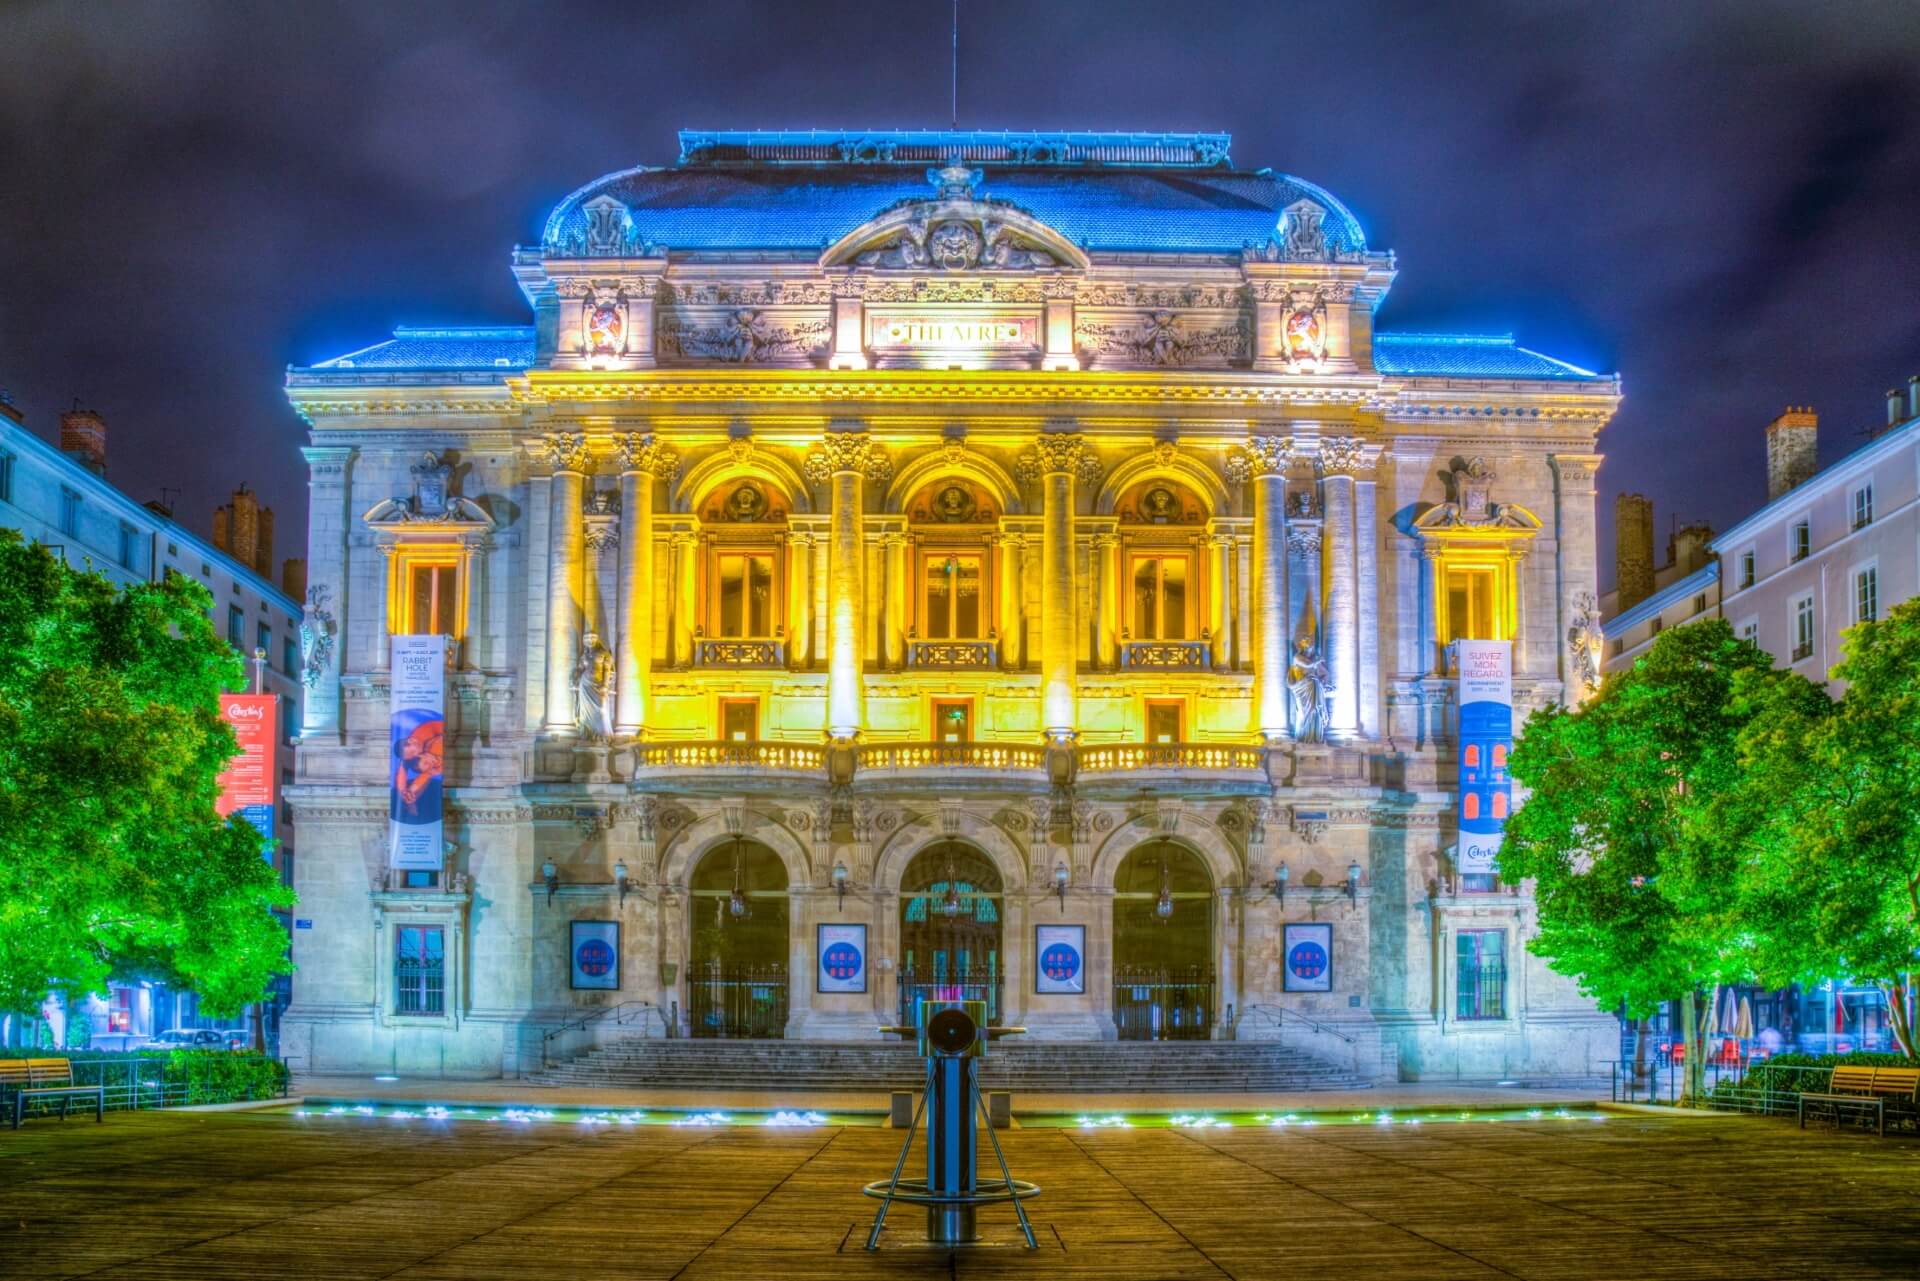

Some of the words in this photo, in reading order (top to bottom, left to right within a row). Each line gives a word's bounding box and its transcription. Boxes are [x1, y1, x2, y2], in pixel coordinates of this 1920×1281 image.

[402, 656, 432, 664] RABBIT
[406, 664, 428, 672] HOLE
[1474, 661, 1497, 669] MON
